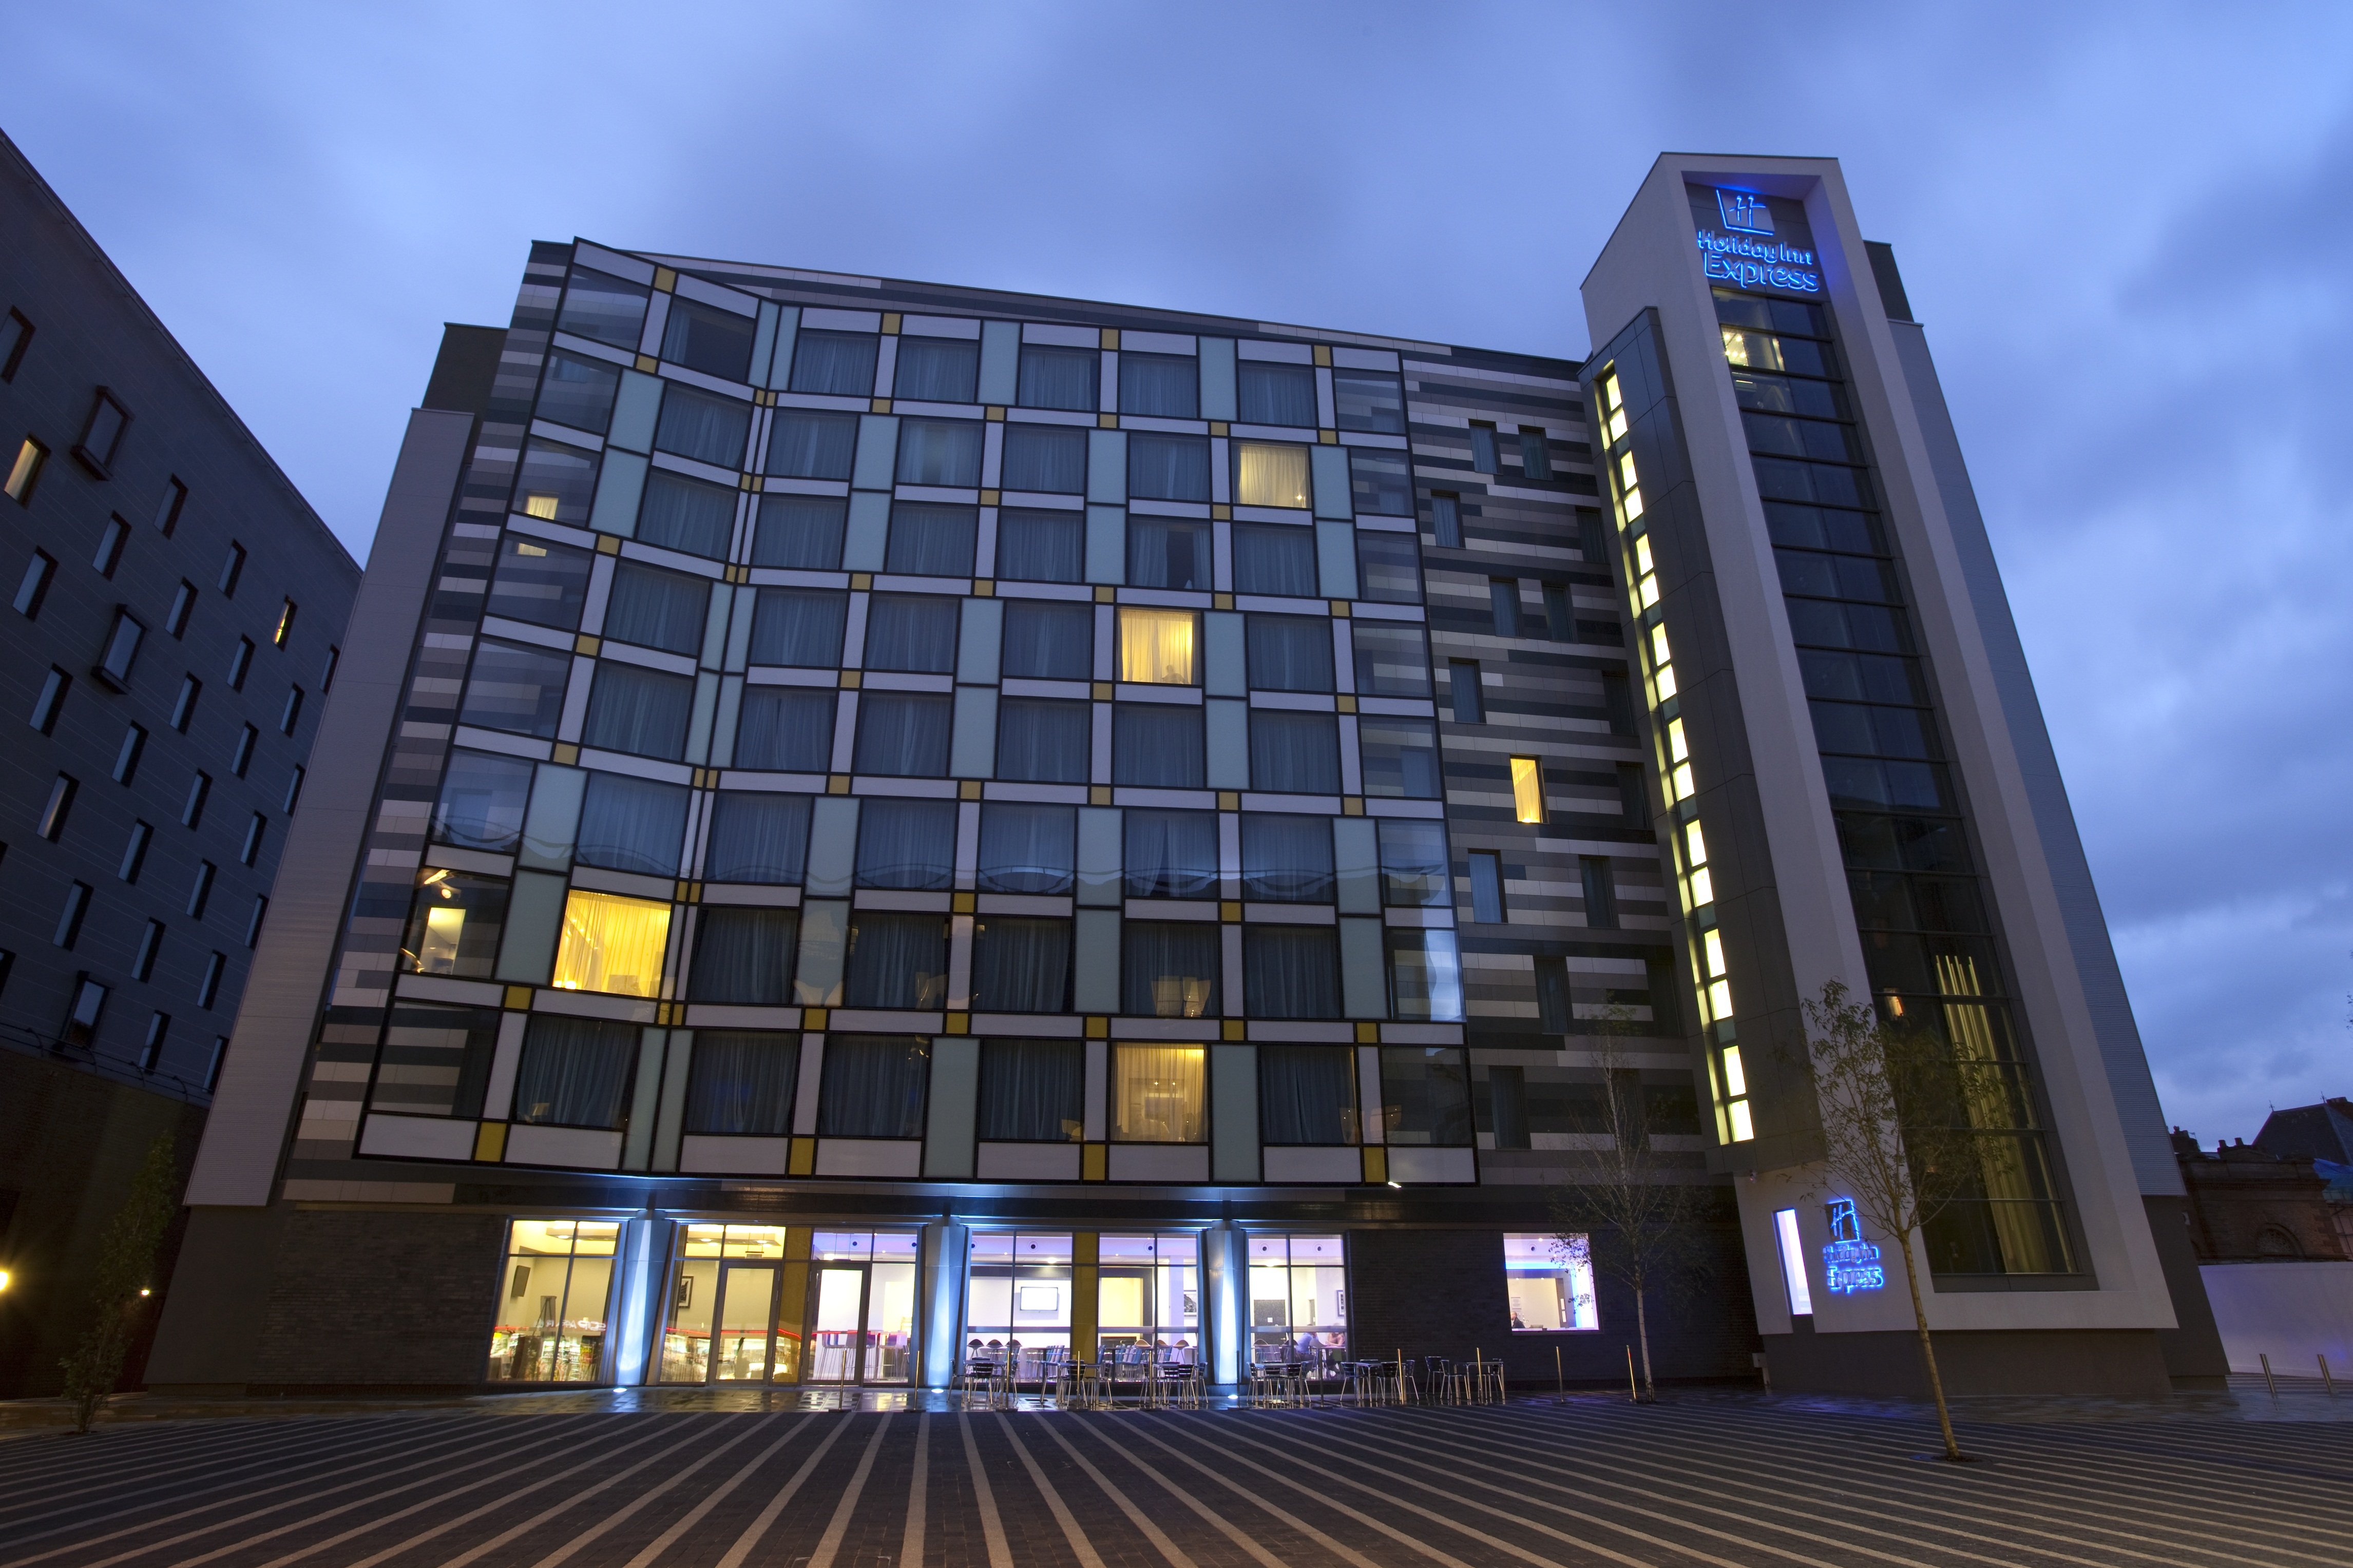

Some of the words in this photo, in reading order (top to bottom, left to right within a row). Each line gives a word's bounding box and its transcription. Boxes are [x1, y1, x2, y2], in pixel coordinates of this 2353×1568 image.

[1697, 229, 1779, 263] Holiday
[1780, 242, 1813, 265] Inn
[1704, 250, 1820, 292] Express
[1827, 1267, 1883, 1293] Express
